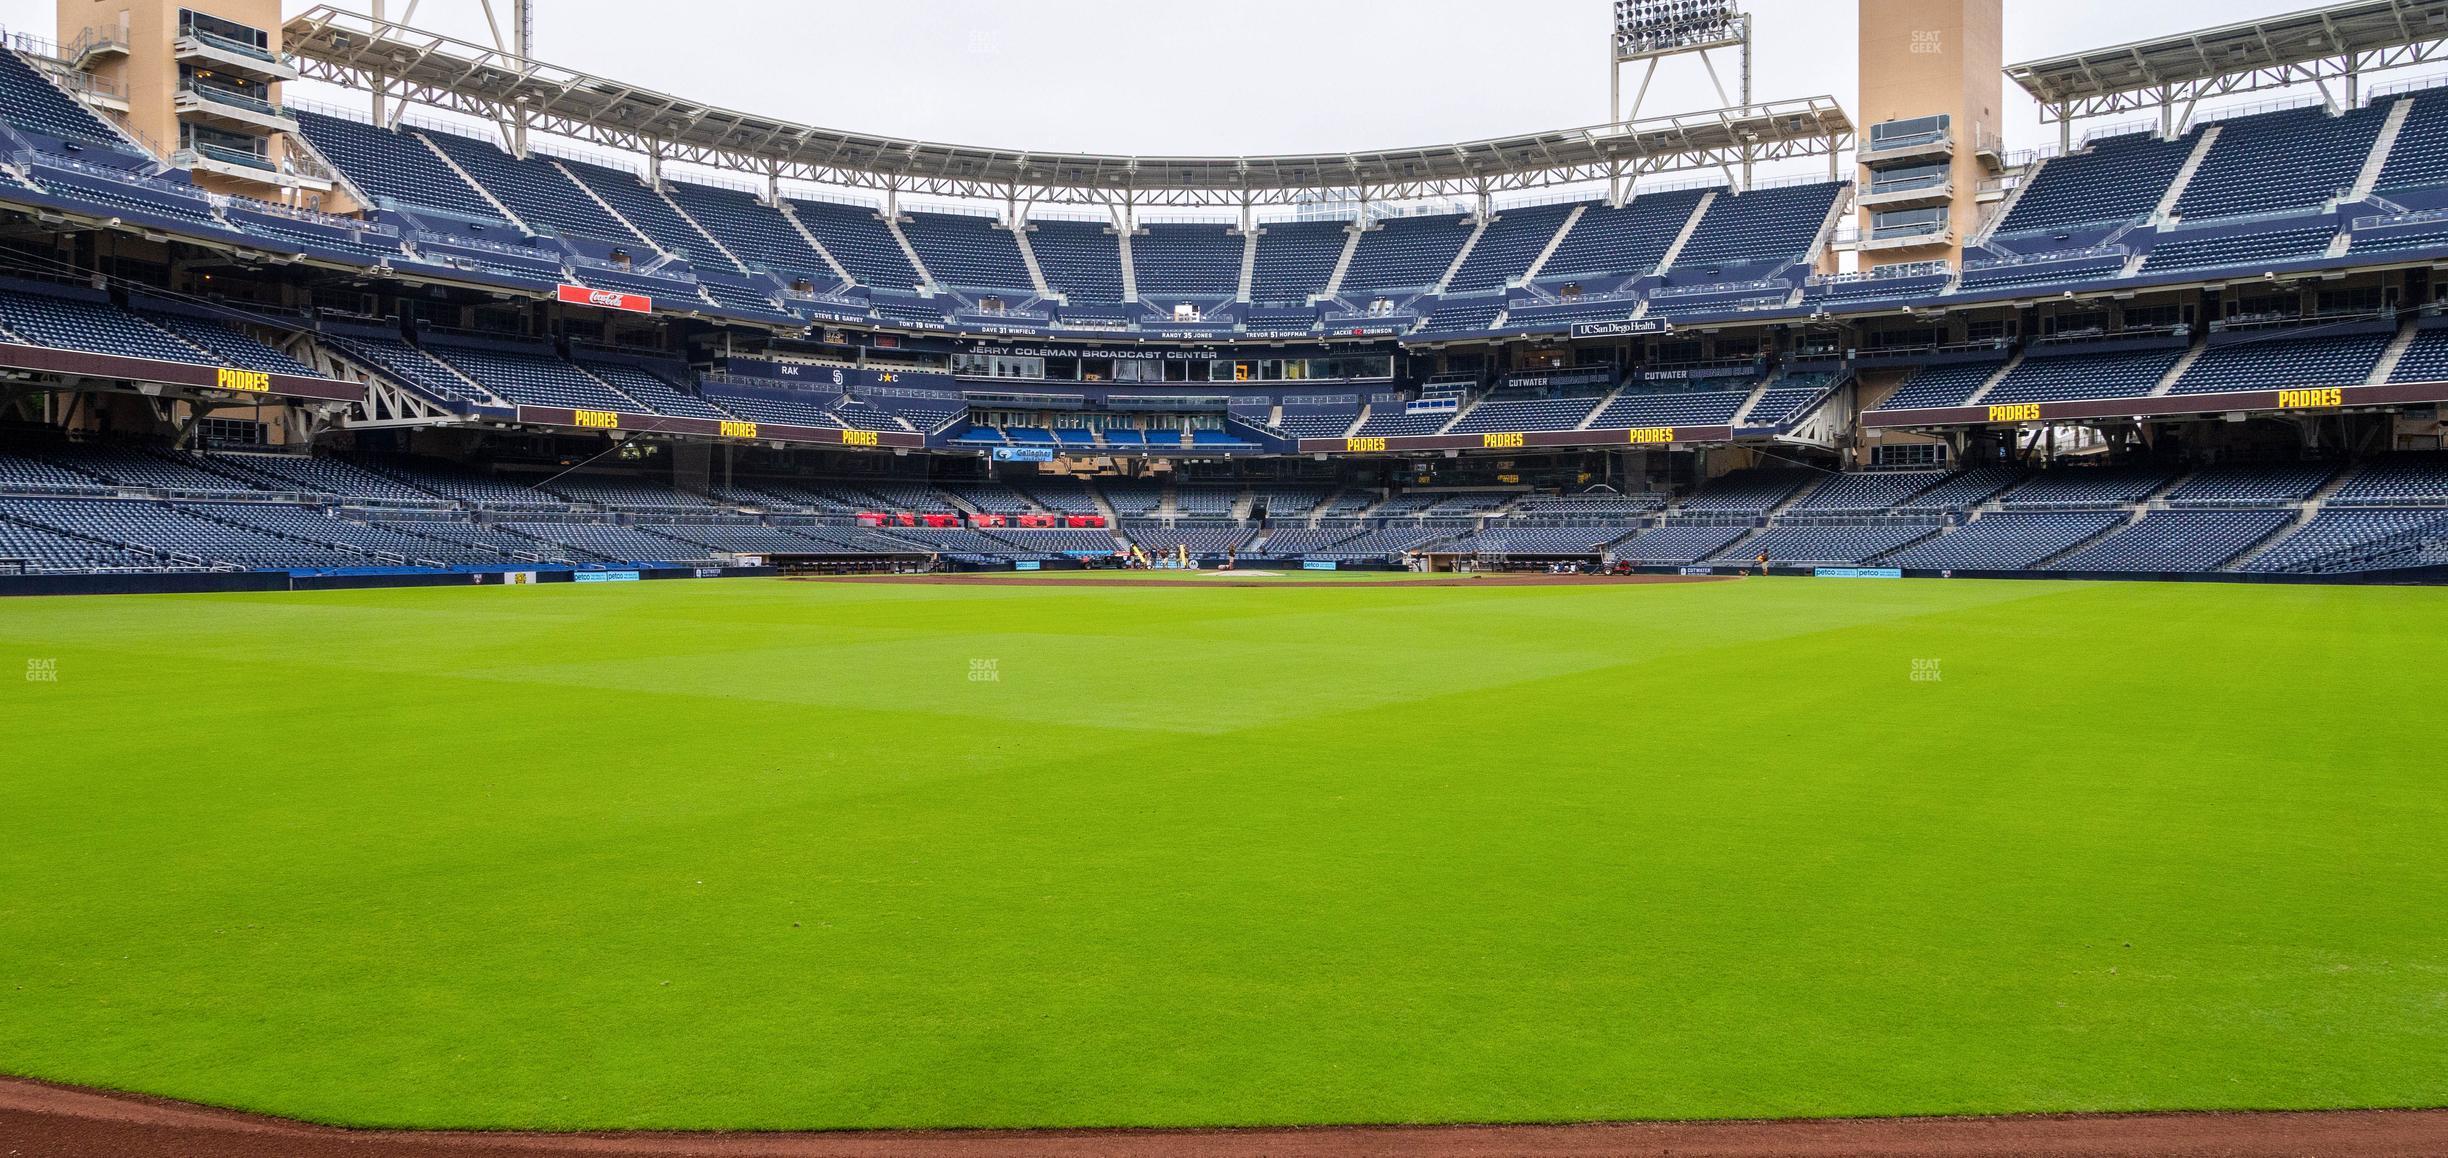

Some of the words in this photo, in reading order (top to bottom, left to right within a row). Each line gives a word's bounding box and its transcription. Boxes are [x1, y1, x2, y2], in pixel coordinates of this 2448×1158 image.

[815, 312, 832, 320] STEVE
[842, 315, 864, 323] GARVEY
[898, 320, 914, 328] TONY
[915, 321, 923, 329] 19
[1580, 325, 1594, 334] UC
[1593, 324, 1608, 334] San
[1608, 323, 1630, 334] Diego
[1631, 321, 1656, 331] Health
[969, 346, 1009, 355] JERRY
[1015, 347, 1077, 358] COLEMAN
[1082, 350, 1161, 359] BROADCAST
[1166, 351, 1217, 360] CENTER
[781, 366, 799, 375] RAK
[1644, 370, 1687, 380] CUTWATER
[218, 368, 269, 392] PADRES
[1509, 378, 1547, 387] CUTWATER
[2278, 388, 2342, 409] PADRES
[575, 410, 618, 428] PADRES
[1989, 403, 2040, 421] PADRES
[720, 421, 757, 438] PADRES
[1630, 428, 1673, 444] PADRES
[842, 430, 878, 446] PADRES
[1347, 437, 1385, 451] PADRES
[1483, 432, 1523, 448] PADRES
[1859, 569, 1879, 577] petco
